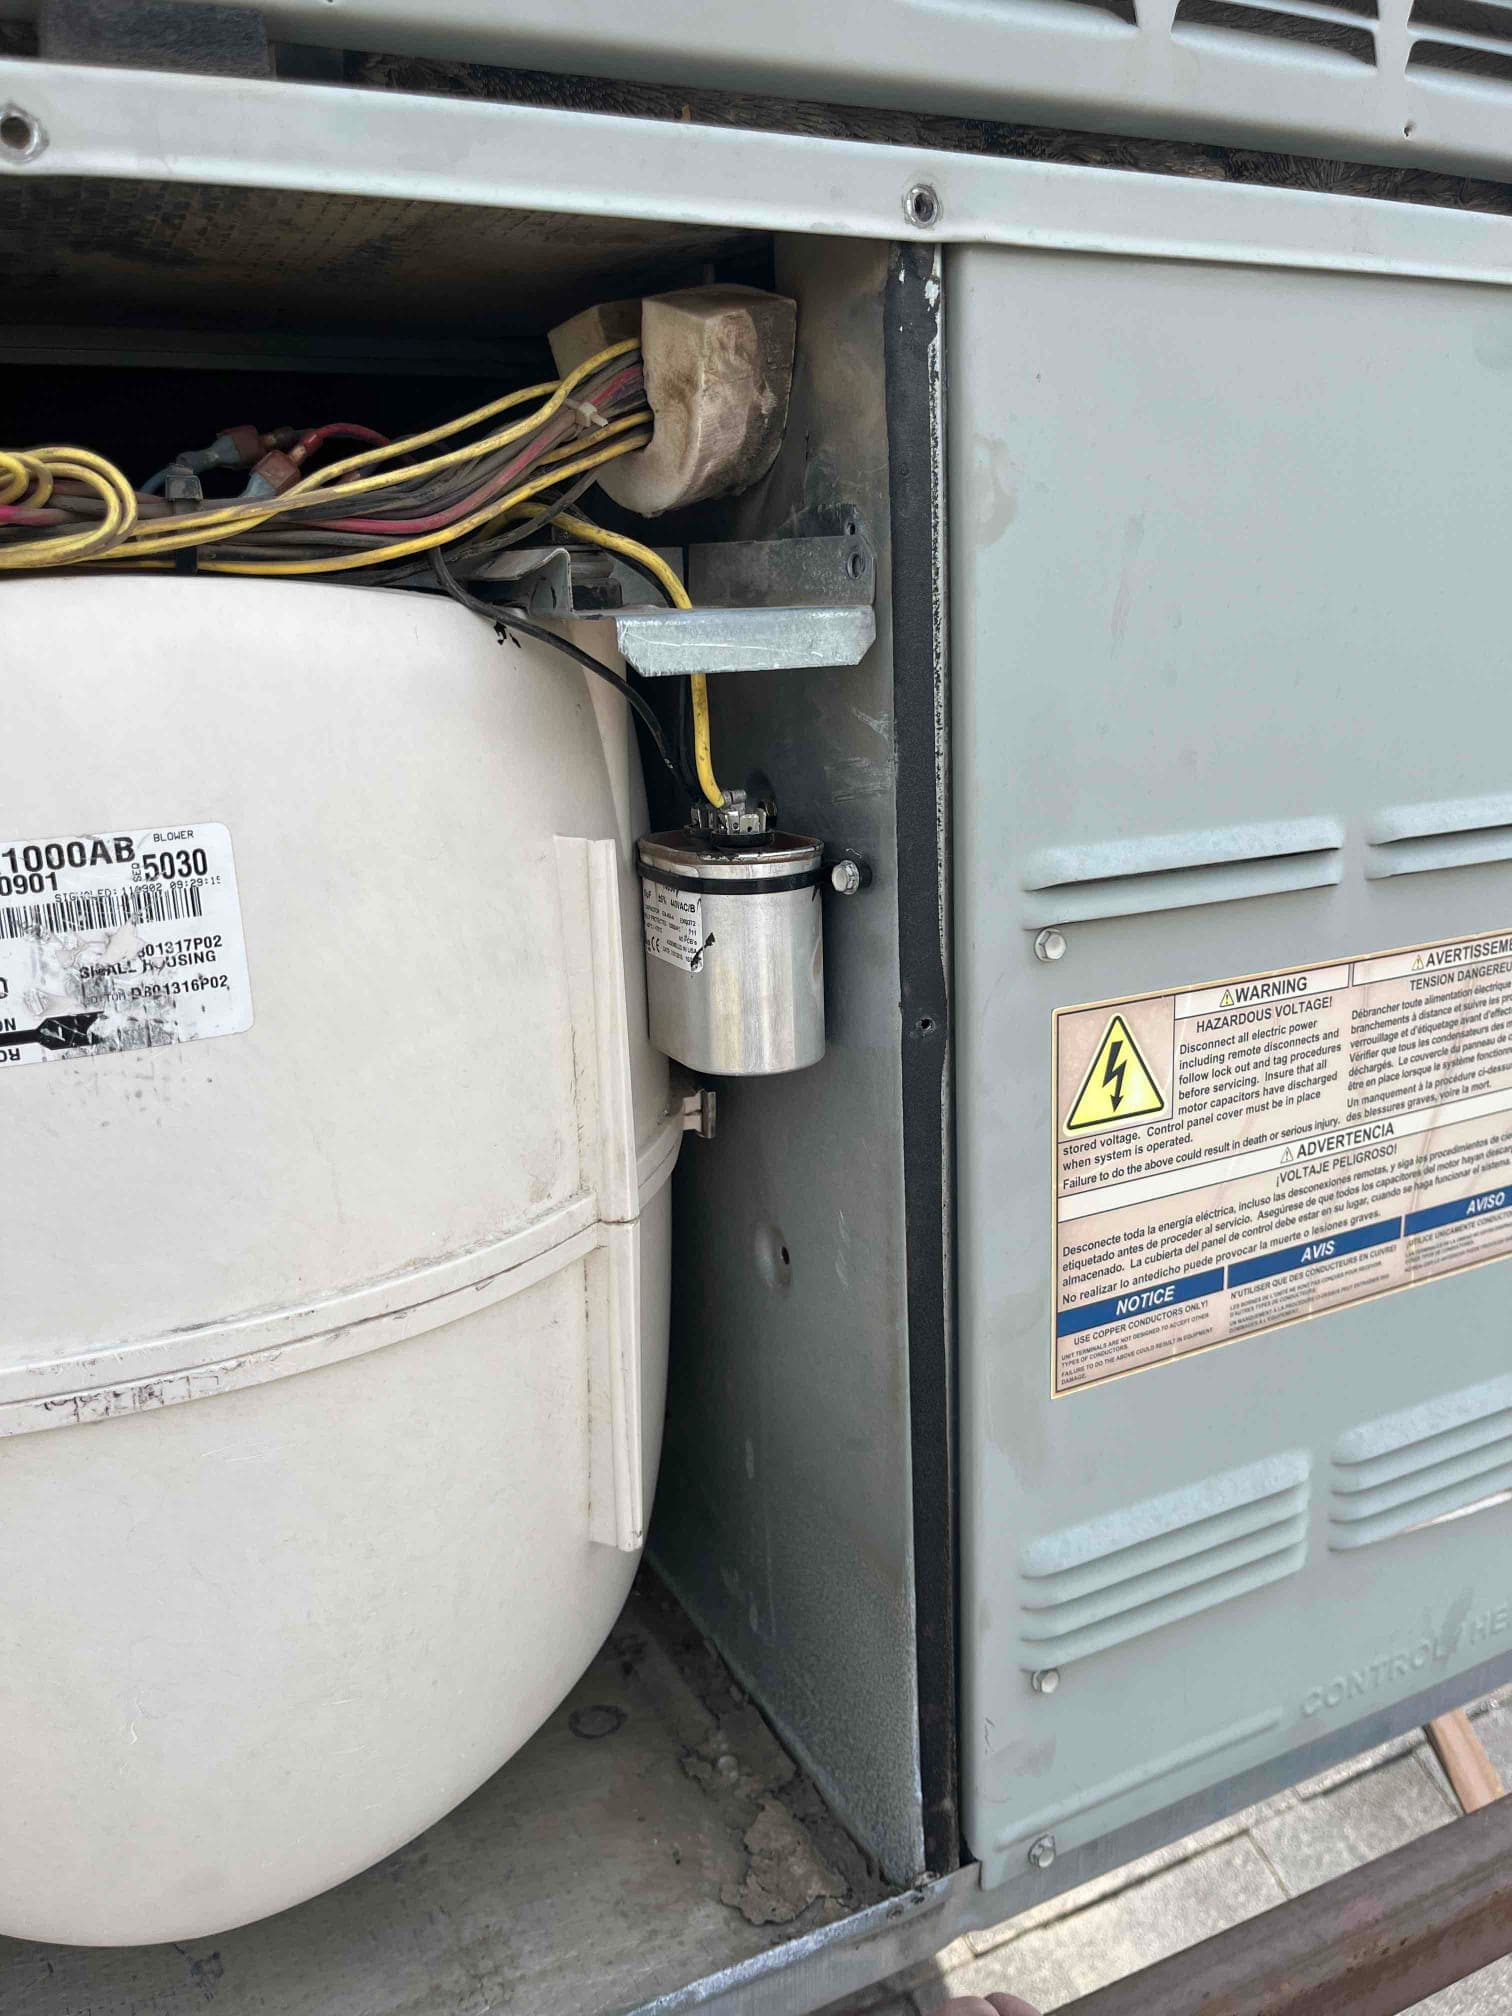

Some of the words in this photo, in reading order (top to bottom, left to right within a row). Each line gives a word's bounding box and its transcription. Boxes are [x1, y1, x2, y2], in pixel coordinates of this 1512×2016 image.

[2, 836, 136, 874] 1000AB
[153, 830, 194, 843] BLOWER
[131, 862, 142, 882] SEQ
[143, 848, 208, 882] 5030
[1235, 976, 1307, 1002] WARNING
[1410, 972, 1454, 991] TENSION
[1196, 1007, 1271, 1033] HAZARDOUS
[1274, 995, 1332, 1017] VOLTAGE!
[1351, 1015, 1409, 1034] branchements
[1412, 1013, 1416, 1021] à
[1419, 1007, 1451, 1020] distance
[1454, 1003, 1461, 1012] et
[1464, 1000, 1486, 1010] suivre
[1352, 1003, 1399, 1019] Débrancher
[1402, 998, 1422, 1009] toute
[1424, 988, 1471, 1005] alimentation
[1179, 1034, 1235, 1055] Disconnect
[1238, 1031, 1248, 1043] all
[1251, 1025, 1286, 1040] electric
[1288, 1020, 1316, 1035] power
[1179, 1053, 1224, 1070] including
[1228, 1045, 1260, 1060] remote
[1264, 1033, 1319, 1052] disconnects
[1322, 1028, 1338, 1040] and
[1178, 1086, 1209, 1100] before
[1212, 1076, 1259, 1093] servicing.
[1265, 1068, 1293, 1081] Insure
[1296, 1061, 1314, 1074] that
[1316, 1059, 1326, 1070] all
[1179, 1071, 1208, 1085] follow
[1211, 1065, 1231, 1078] lock
[1234, 1061, 1250, 1073] out
[1253, 1056, 1269, 1069] and
[1272, 1055, 1287, 1065] tag
[1290, 1043, 1341, 1063] procedures
[1178, 1102, 1207, 1115] motor
[1210, 1090, 1259, 1108] capacitors
[1263, 1084, 1284, 1096] have
[1287, 1070, 1337, 1090] discharged
[1346, 1112, 1361, 1121] des
[1364, 1101, 1404, 1117] blessures
[1407, 1095, 1436, 1108] graves,
[1347, 1098, 1358, 1108] Un
[1362, 1083, 1416, 1104] manquement
[1419, 1081, 1423, 1091] à
[1425, 1080, 1432, 1089] la
[1435, 1071, 1475, 1089] procédure
[1063, 1139, 1096, 1157] stored
[1099, 1133, 1140, 1148] voltage.
[1146, 1119, 1184, 1137] Control
[1187, 1112, 1213, 1130] panel
[1216, 1108, 1242, 1121] cover
[1245, 1100, 1268, 1114] must
[1271, 1098, 1282, 1108] be
[1286, 1095, 1293, 1105] in
[1296, 1090, 1320, 1105] place
[1296, 1121, 1393, 1158] ADVERTENCIA
[1063, 1158, 1090, 1172] when
[1094, 1148, 1131, 1165] system
[1135, 1144, 1143, 1155] is
[1146, 1133, 1192, 1153] operated.
[1063, 1174, 1096, 1190] Failure
[1099, 1170, 1108, 1181] to
[1112, 1167, 1124, 1178] do
[1127, 1162, 1141, 1174] the
[1145, 1156, 1173, 1170] above
[1176, 1147, 1201, 1162] could
[1204, 1140, 1229, 1156] result
[1232, 1139, 1240, 1149] in
[1243, 1131, 1266, 1146] death
[1269, 1131, 1278, 1140] or
[1281, 1122, 1312, 1137] serious
[1315, 1117, 1340, 1129] injury.
[1276, 1160, 1329, 1186] ¡VOLTAJE
[1332, 1143, 1396, 1169] PELIGROSO!
[1063, 1234, 1120, 1257] Desconecte
[1123, 1227, 1144, 1241] toda
[1147, 1224, 1155, 1234] la
[1158, 1215, 1192, 1232] energía
[1195, 1205, 1236, 1222] eléctrica,
[1238, 1195, 1270, 1210] incluso
[1273, 1191, 1285, 1201] las
[1287, 1174, 1350, 1197] desconexiones
[1353, 1166, 1388, 1180] remotas,
[1390, 1163, 1395, 1172] y
[1466, 1191, 1504, 1214] AVISO
[1062, 1264, 1124, 1287] almacenado.
[1130, 1258, 1142, 1268] La
[1144, 1246, 1182, 1264] cubierta
[1185, 1241, 1198, 1253] del
[1201, 1233, 1226, 1251] panel
[1228, 1231, 1239, 1241] de
[1241, 1220, 1272, 1237] control
[1275, 1215, 1295, 1228] debe
[1298, 1210, 1319, 1222] estar
[1321, 1207, 1331, 1216] en
[1334, 1203, 1344, 1212] su
[1346, 1197, 1369, 1209] lugar,
[1371, 1187, 1401, 1202] cuando
[1063, 1250, 1114, 1272] etiquetado
[1117, 1243, 1143, 1257] antes
[1146, 1239, 1158, 1249] de
[1160, 1228, 1201, 1248] proceder
[1205, 1223, 1212, 1233] al
[1215, 1214, 1252, 1231] servicio.
[1257, 1200, 1303, 1219] Asegúrese
[1305, 1197, 1316, 1207] de
[1318, 1193, 1333, 1205] que
[1336, 1186, 1359, 1198] todos
[1362, 1182, 1373, 1191] los
[1062, 1294, 1076, 1305] No
[1079, 1283, 1115, 1300] realizar
[1120, 1278, 1129, 1288] lo
[1132, 1264, 1180, 1285] antedicho
[1183, 1255, 1212, 1272] puede
[1216, 1243, 1256, 1263] provocar
[1259, 1239, 1267, 1249] la
[1270, 1230, 1300, 1246] muerte
[1303, 1228, 1308, 1236] o
[1311, 1218, 1347, 1235] lesiones
[1350, 1210, 1380, 1226] graves.
[1300, 1240, 1335, 1263] AVIS
[1116, 1285, 1174, 1316] NOTICE
[1062, 1353, 1074, 1361] UNIT
[1075, 1343, 1106, 1357] TERMINALS
[1108, 1339, 1118, 1347] ARE
[1120, 1335, 1131, 1343] NOT
[1133, 1327, 1159, 1340] DESIGNED
[1169, 1318, 1189, 1328] ACCEPT
[1191, 1312, 1208, 1322] OTHER
[1074, 1333, 1090, 1346] USE
[1092, 1323, 1125, 1340] COPPER
[1128, 1306, 1182, 1330] CONDUCTORS
[1185, 1299, 1207, 1313] ONLY!
